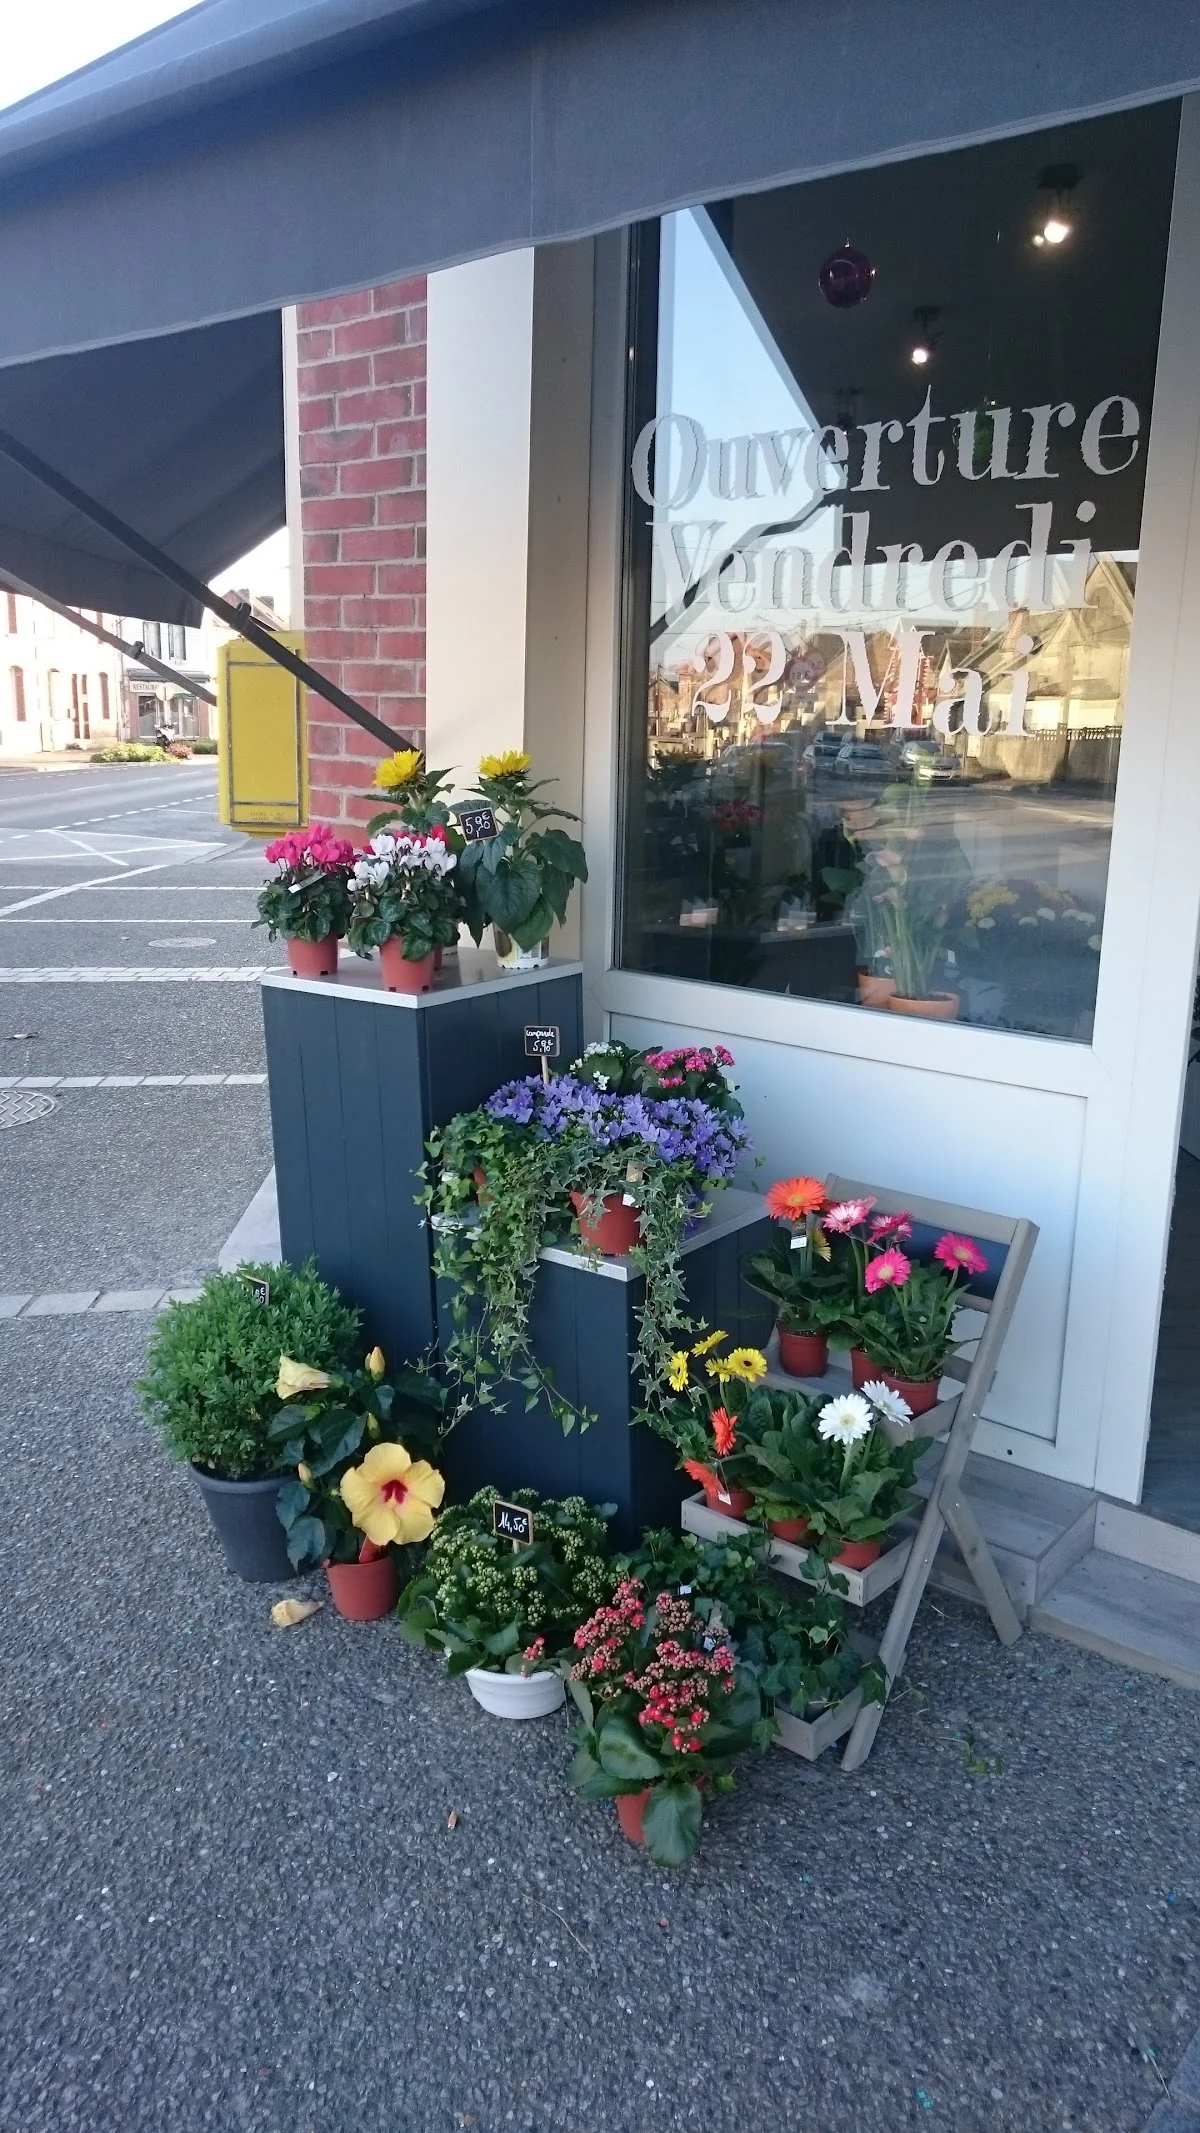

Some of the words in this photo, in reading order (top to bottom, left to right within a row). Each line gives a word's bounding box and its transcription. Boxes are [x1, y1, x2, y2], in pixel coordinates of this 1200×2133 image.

[631, 384, 1141, 511] Ouverture
[645, 501, 1098, 613] Vendredi
[132, 684, 159, 692] RESTAURA
[692, 631, 787, 725] 22
[825, 630, 1036, 737] Mai
[497, 1511, 528, 1533] 14,50€
